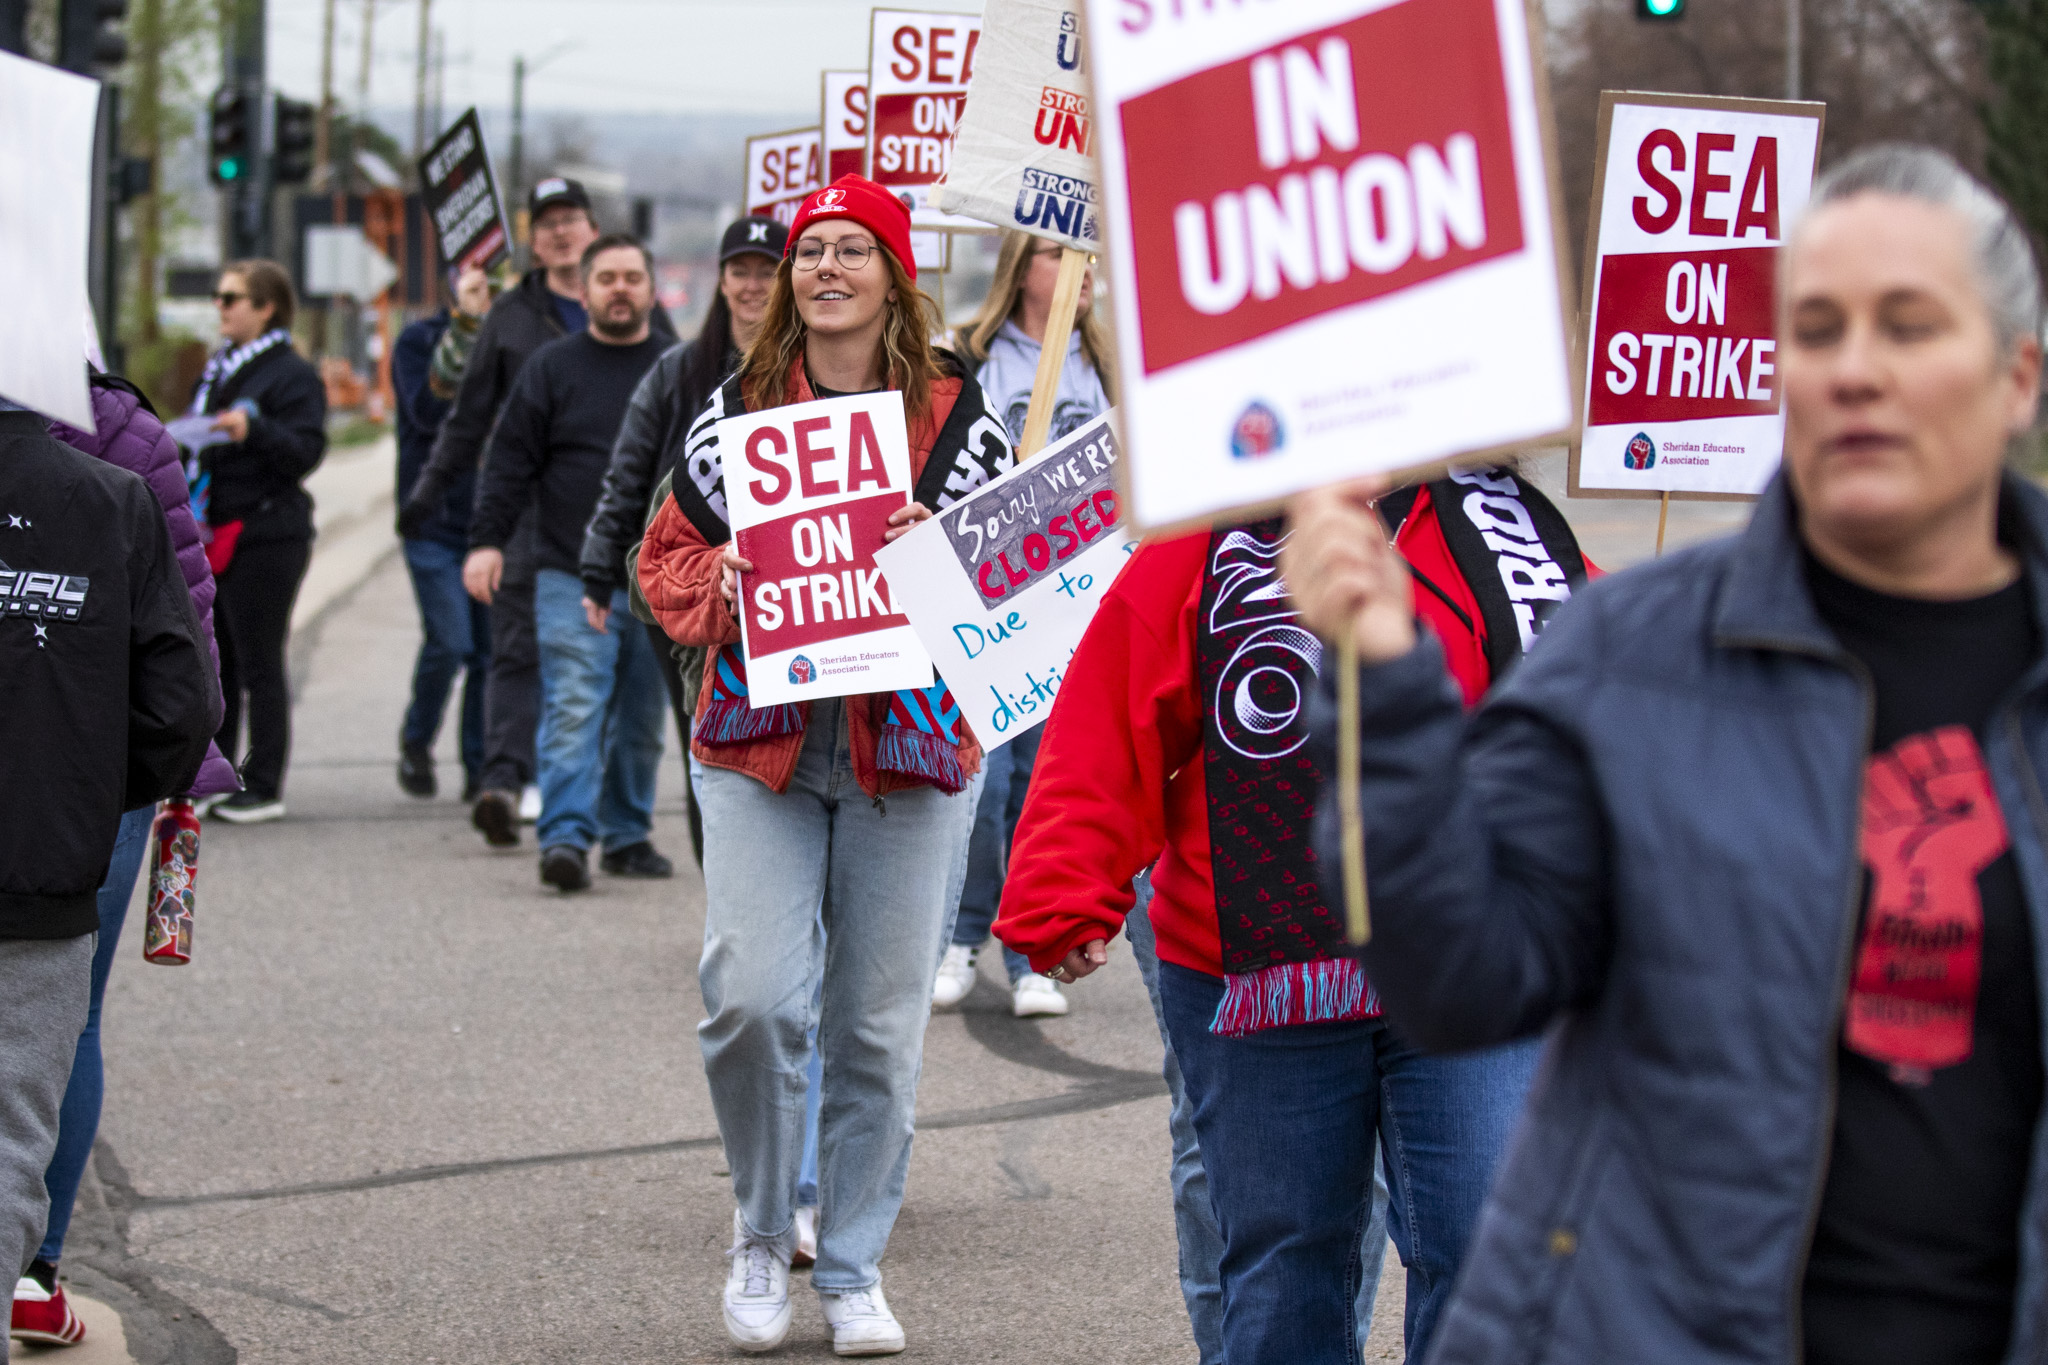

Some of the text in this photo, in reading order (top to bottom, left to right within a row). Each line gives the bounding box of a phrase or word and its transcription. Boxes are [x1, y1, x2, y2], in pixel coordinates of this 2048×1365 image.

[913, 95, 957, 134] ON
[1042, 88, 1089, 116] STRO
[1250, 36, 1358, 169] IN
[761, 143, 823, 194] SEA
[879, 134, 952, 174] STRI
[1632, 128, 1780, 240] SEA
[1173, 132, 1487, 316] UNION
[1665, 260, 1728, 325] ON
[1605, 331, 1777, 400] STRIKE
[745, 411, 891, 506] SEA
[1661, 455, 1710, 466] Association
[1662, 442, 1746, 454] Sheridan Educators
[957, 484, 1041, 564] Sorry
[1042, 432, 1119, 495] WE'RE
[791, 513, 854, 567] ON
[977, 489, 1125, 599] CLOSED
[953, 571, 1094, 660] Due to
[820, 650, 900, 666] Sheridan Educators
[821, 664, 871, 676] Association
[990, 648, 1076, 733] distri
